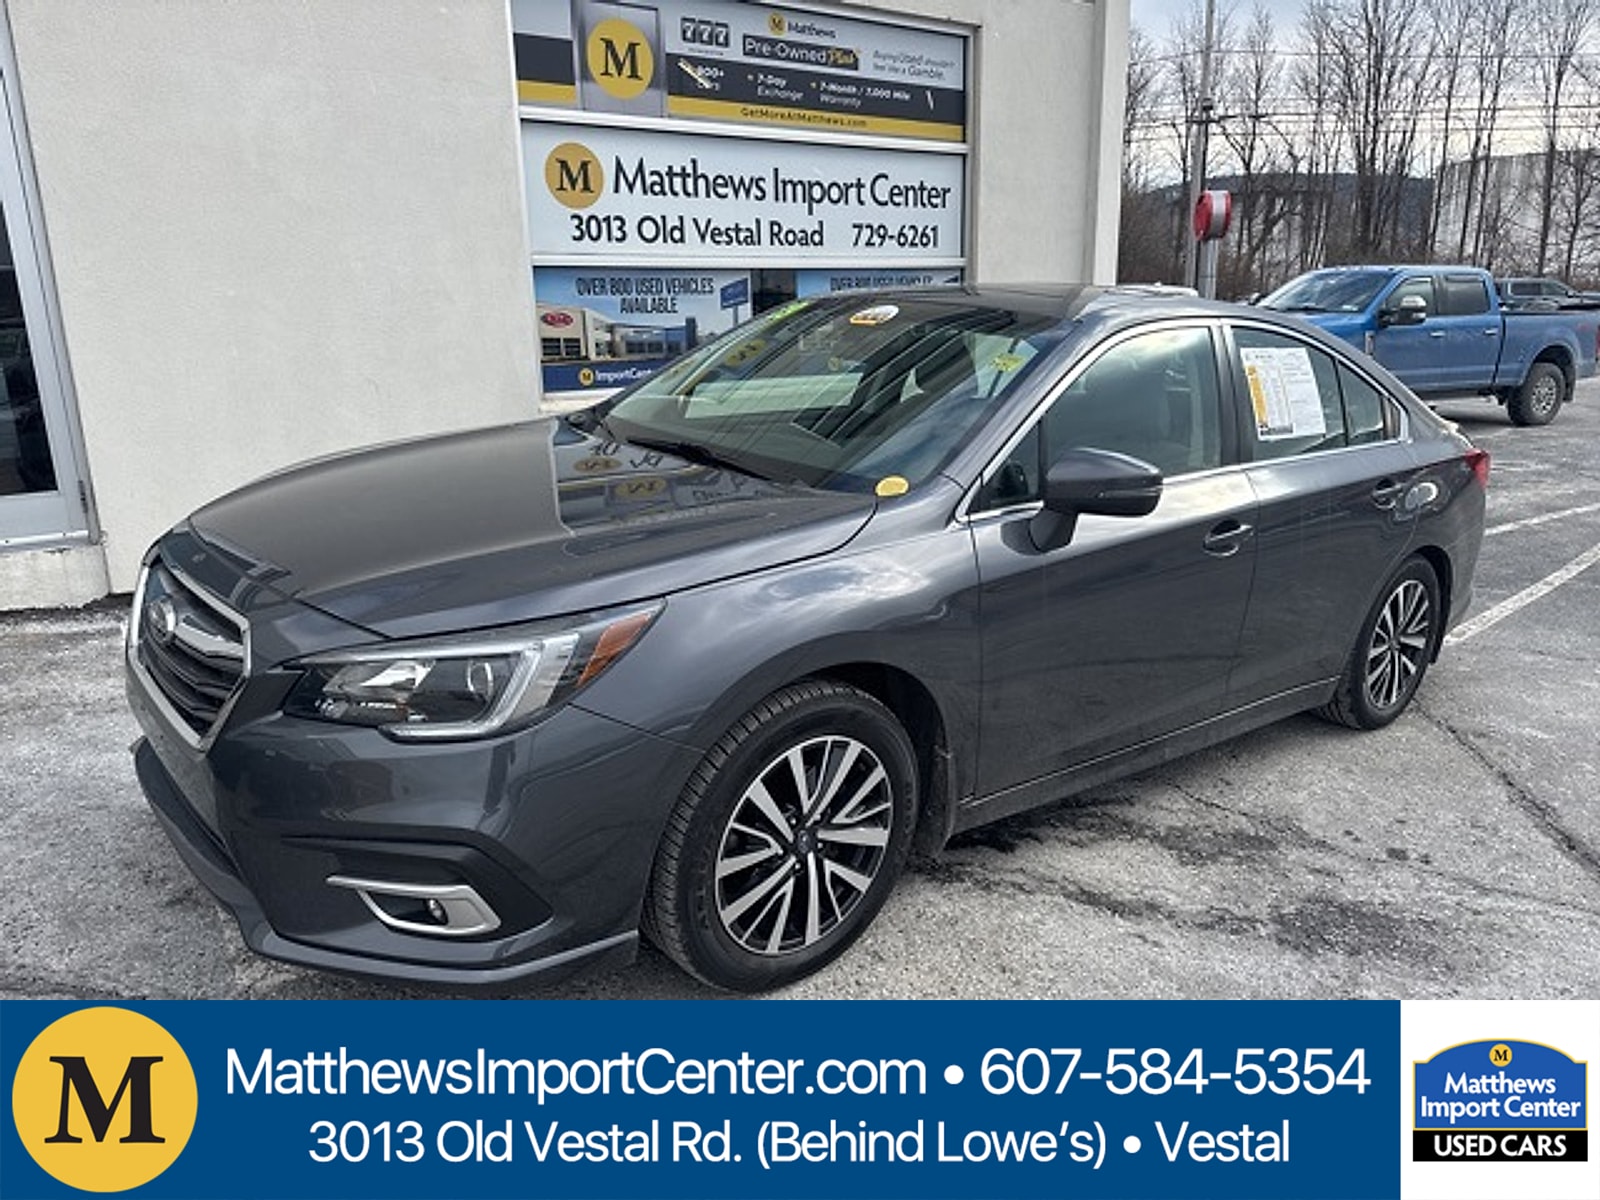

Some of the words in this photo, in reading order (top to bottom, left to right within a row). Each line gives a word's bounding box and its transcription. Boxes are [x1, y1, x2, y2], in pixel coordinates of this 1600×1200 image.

[599, 37, 643, 81] M
[744, 37, 827, 64] Pre-Owned
[555, 157, 595, 194] M
[613, 154, 767, 201] Matthews
[773, 167, 866, 216] Import
[870, 172, 951, 208] Center
[570, 213, 628, 243] 3013
[637, 214, 687, 244] Old
[693, 217, 762, 247] Vestal
[769, 219, 825, 247] Road
[852, 222, 939, 249] 729-6261
[575, 277, 607, 296] OVER
[610, 277, 633, 296] 800
[635, 277, 663, 296] USED
[665, 277, 714, 295] VEHICLES
[619, 297, 679, 315] AVAILABLE
